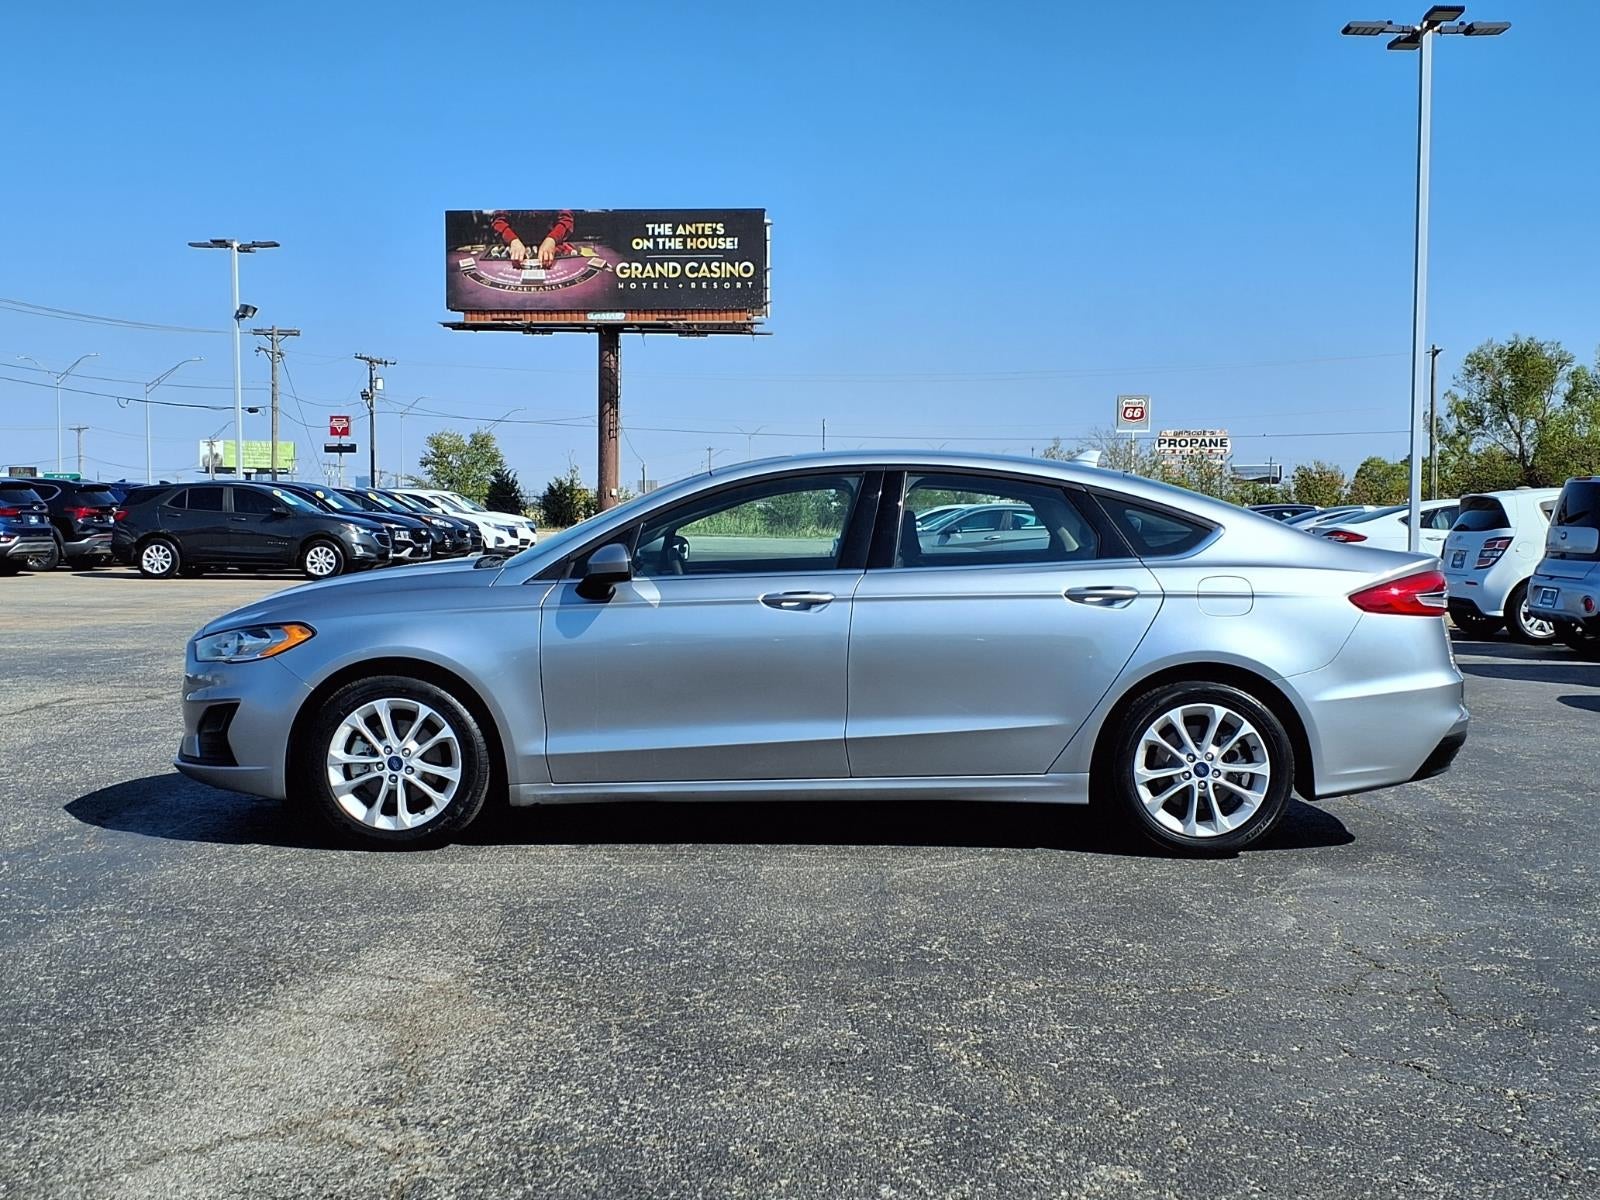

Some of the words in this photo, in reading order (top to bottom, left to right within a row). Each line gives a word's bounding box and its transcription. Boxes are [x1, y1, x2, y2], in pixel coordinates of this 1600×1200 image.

[646, 223, 673, 235] THE
[675, 222, 725, 235] ANTE'S
[631, 238, 654, 250] ON
[656, 238, 684, 250] THE
[686, 237, 739, 250] HOUSE!
[615, 262, 681, 278] GRAND
[684, 261, 755, 278] CASINO
[690, 281, 753, 289] RESORT
[1125, 408, 1142, 418] 66
[1157, 438, 1228, 448] PROPANE
